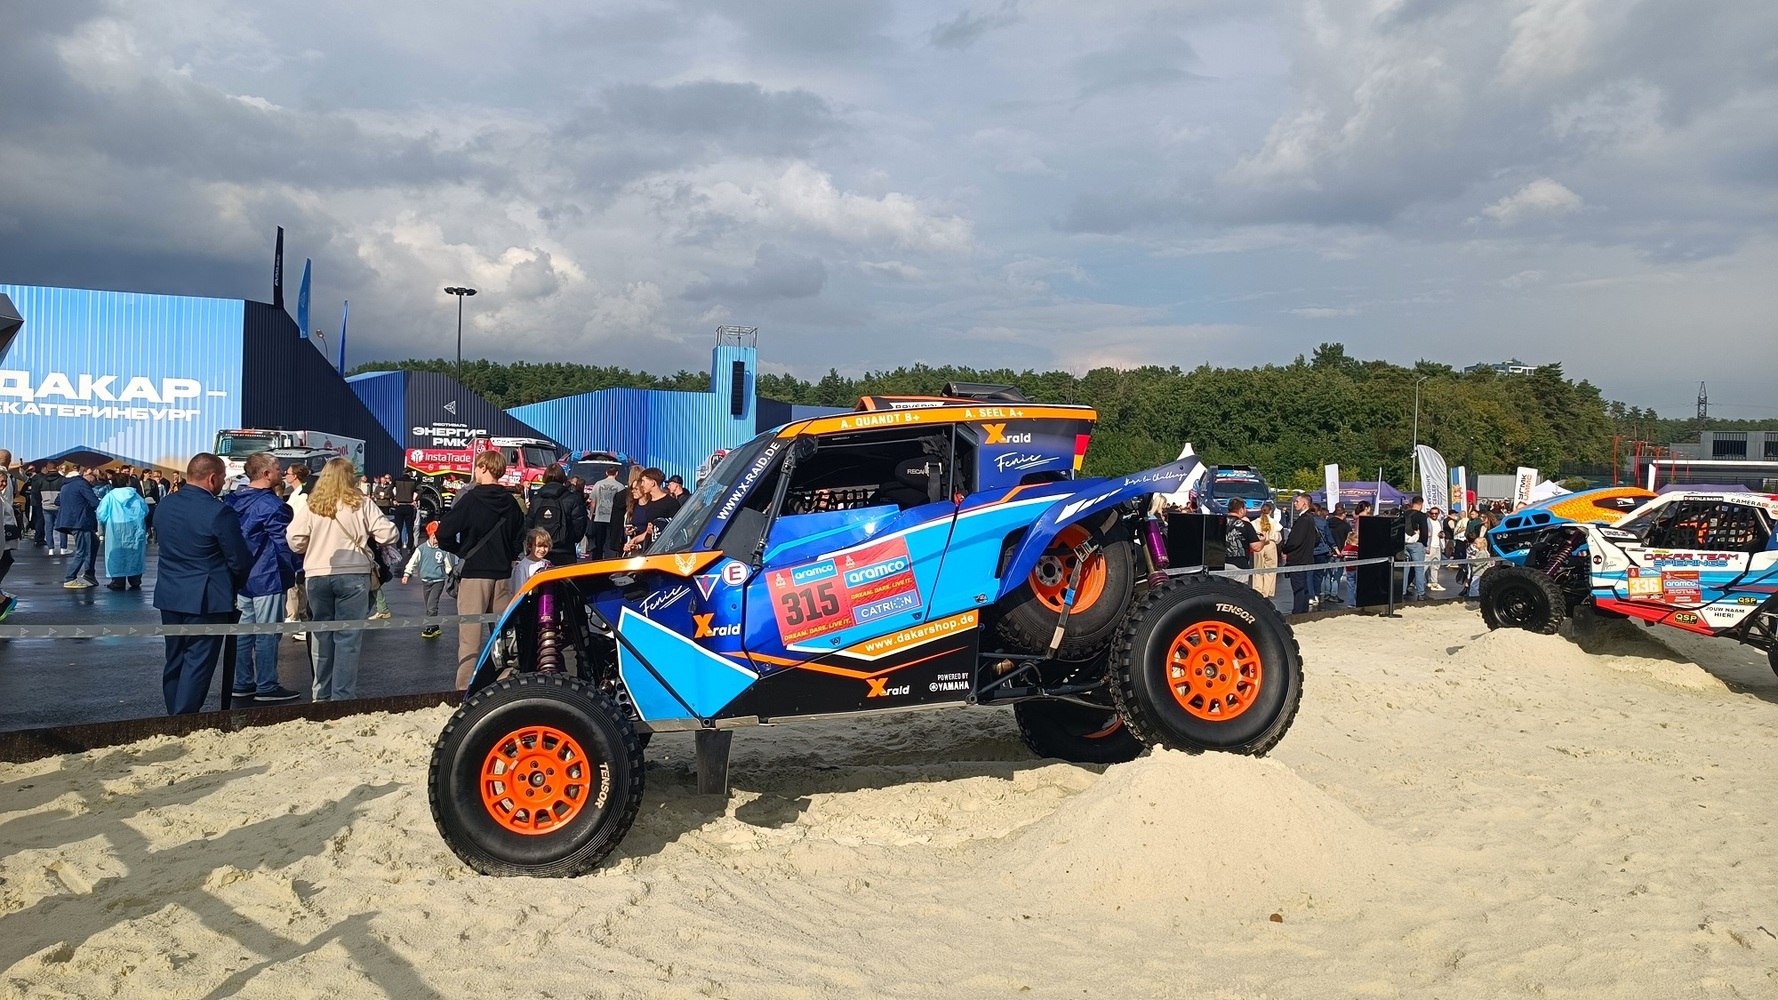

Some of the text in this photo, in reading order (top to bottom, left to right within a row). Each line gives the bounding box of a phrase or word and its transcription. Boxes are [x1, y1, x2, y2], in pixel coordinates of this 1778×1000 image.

[0, 401, 201, 422] КАТЕРИНБУРГ
[979, 408, 1008, 417] SEEL
[1009, 408, 1024, 417] A+
[855, 413, 901, 427] QUANDT
[905, 413, 920, 422] B+
[412, 426, 487, 438] ЭНЕРГИЯ
[432, 437, 468, 447] РМК
[425, 452, 471, 463] InstaTrade
[716, 441, 781, 520] WWW.X-RAID.DE
[1518, 473, 1528, 500] УГМК
[1643, 553, 1739, 561] DAKAR TEAM
[728, 565, 742, 581] E
[794, 564, 834, 580] aramco
[849, 560, 905, 583] aramco
[781, 582, 840, 626] 315
[860, 595, 912, 618] CATRION
[1215, 602, 1256, 625] TENSOR
[1675, 613, 1698, 621] QSP
[865, 614, 974, 652] www.dakarshop.de
[937, 673, 961, 681] POWERED
[937, 681, 970, 691] YAMAHA
[594, 761, 611, 810] TENSOR
